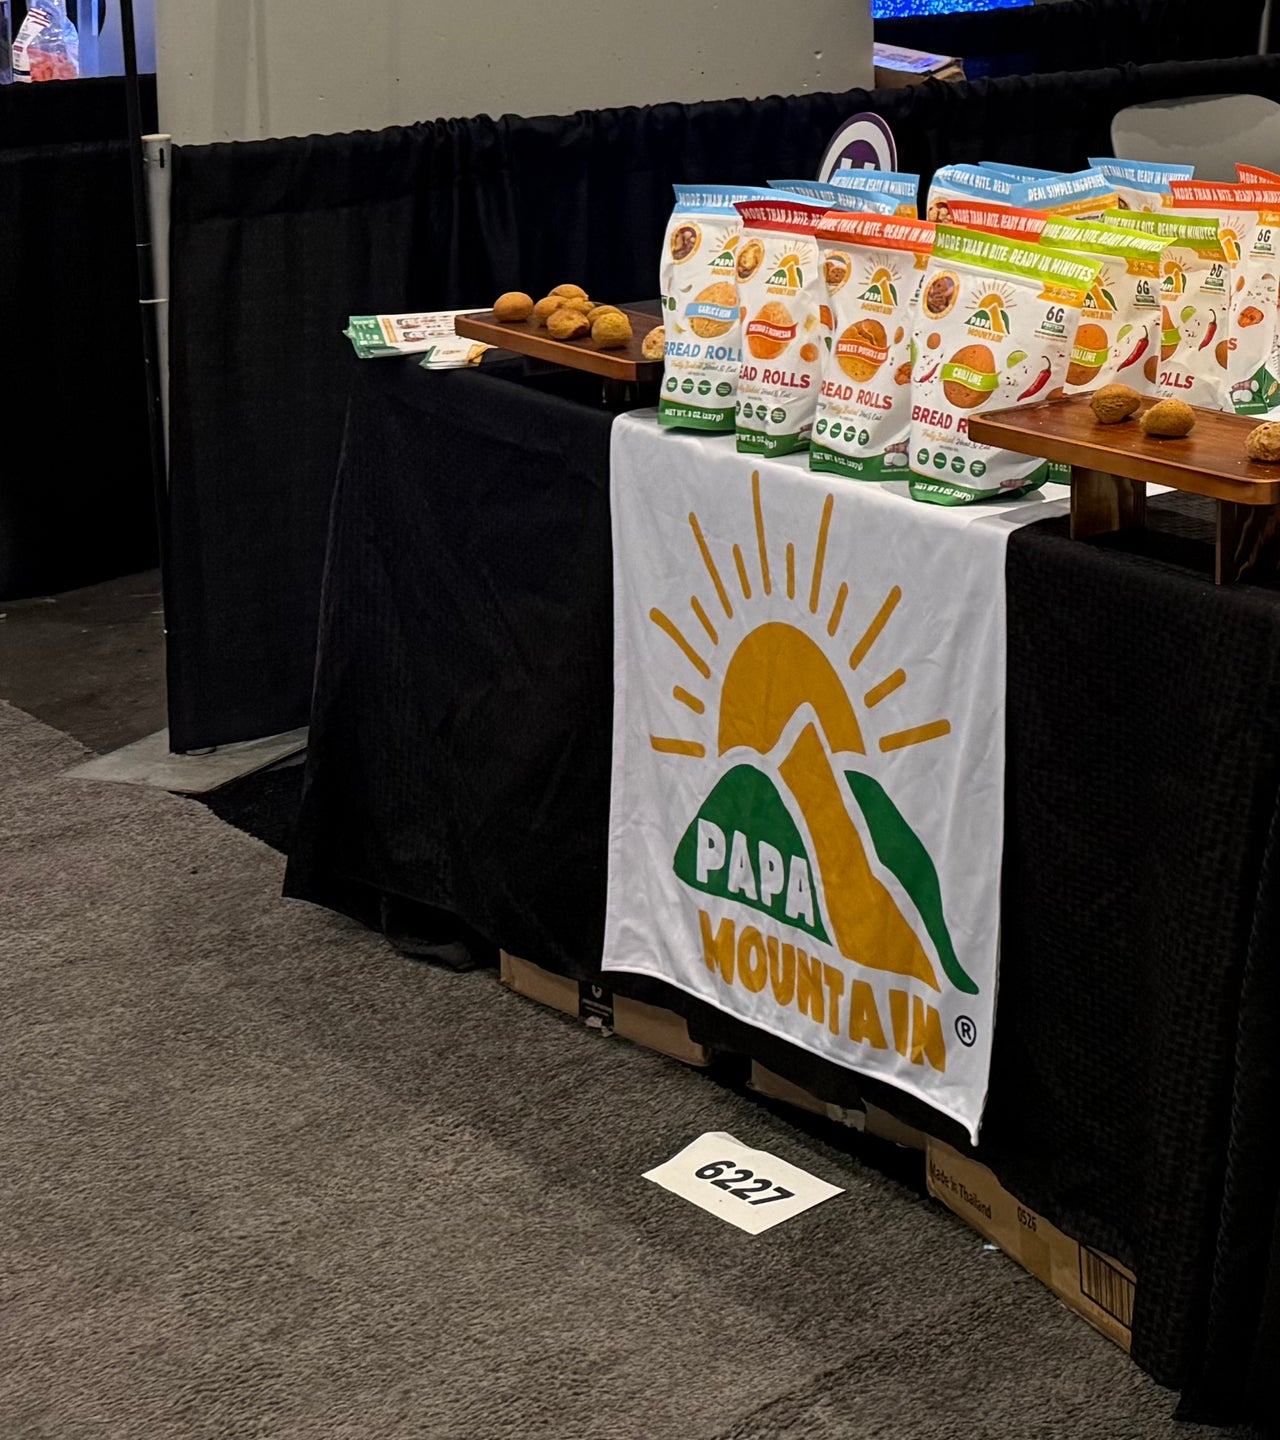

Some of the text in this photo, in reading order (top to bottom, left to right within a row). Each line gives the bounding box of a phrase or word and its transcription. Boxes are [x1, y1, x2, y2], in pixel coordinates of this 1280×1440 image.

[1047, 179, 1071, 197] SIMPLE
[1174, 188, 1256, 203] MORE READY
[884, 224, 921, 241] READY IN
[1099, 231, 1124, 247] READY
[1257, 228, 1271, 242] 6G
[715, 257, 734, 267] PAPA
[937, 233, 1095, 282] MORE THAN A BITE. READY IN MINUTES
[770, 276, 787, 286] PAPA
[1137, 280, 1150, 294] 6G
[970, 316, 990, 329] PAPA
[1046, 308, 1065, 323] 6G
[665, 341, 701, 357] BREAD
[838, 343, 857, 353] SWEET
[762, 370, 811, 388] ROLLS
[967, 372, 983, 385] LIME
[820, 380, 893, 410] READ ROLLS
[912, 405, 953, 430] BREAD
[696, 817, 815, 927] PAPA
[694, 1159, 795, 1206] 6227
[930, 1158, 950, 1188] Made
[959, 1183, 992, 1219] Thailand
